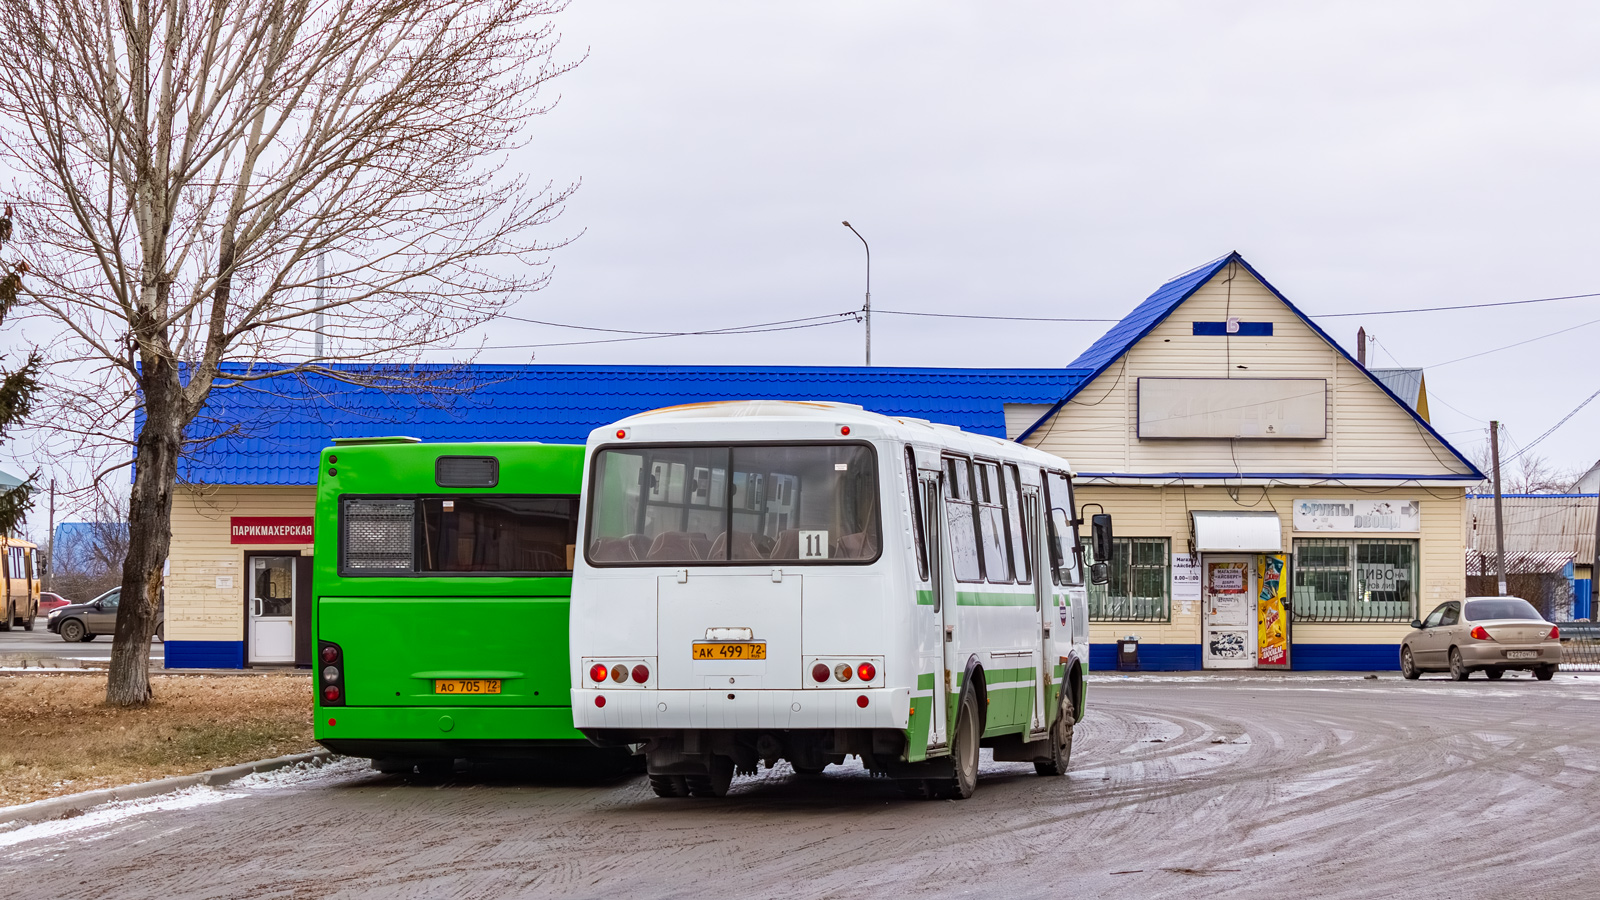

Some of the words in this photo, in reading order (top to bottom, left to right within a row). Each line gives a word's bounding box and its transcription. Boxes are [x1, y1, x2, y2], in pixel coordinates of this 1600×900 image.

[1300, 503, 1354, 516] ФРУКТЫ
[232, 525, 312, 536] ПАРИКМАХЕРСКАЯ
[806, 534, 822, 557] 11
[1357, 569, 1394, 580] ПИВО
[699, 648, 714, 658] АК
[720, 645, 743, 657] 499
[750, 644, 762, 654] 72
[441, 683, 455, 692] АО
[459, 681, 480, 692] 705
[487, 681, 497, 689] 72
